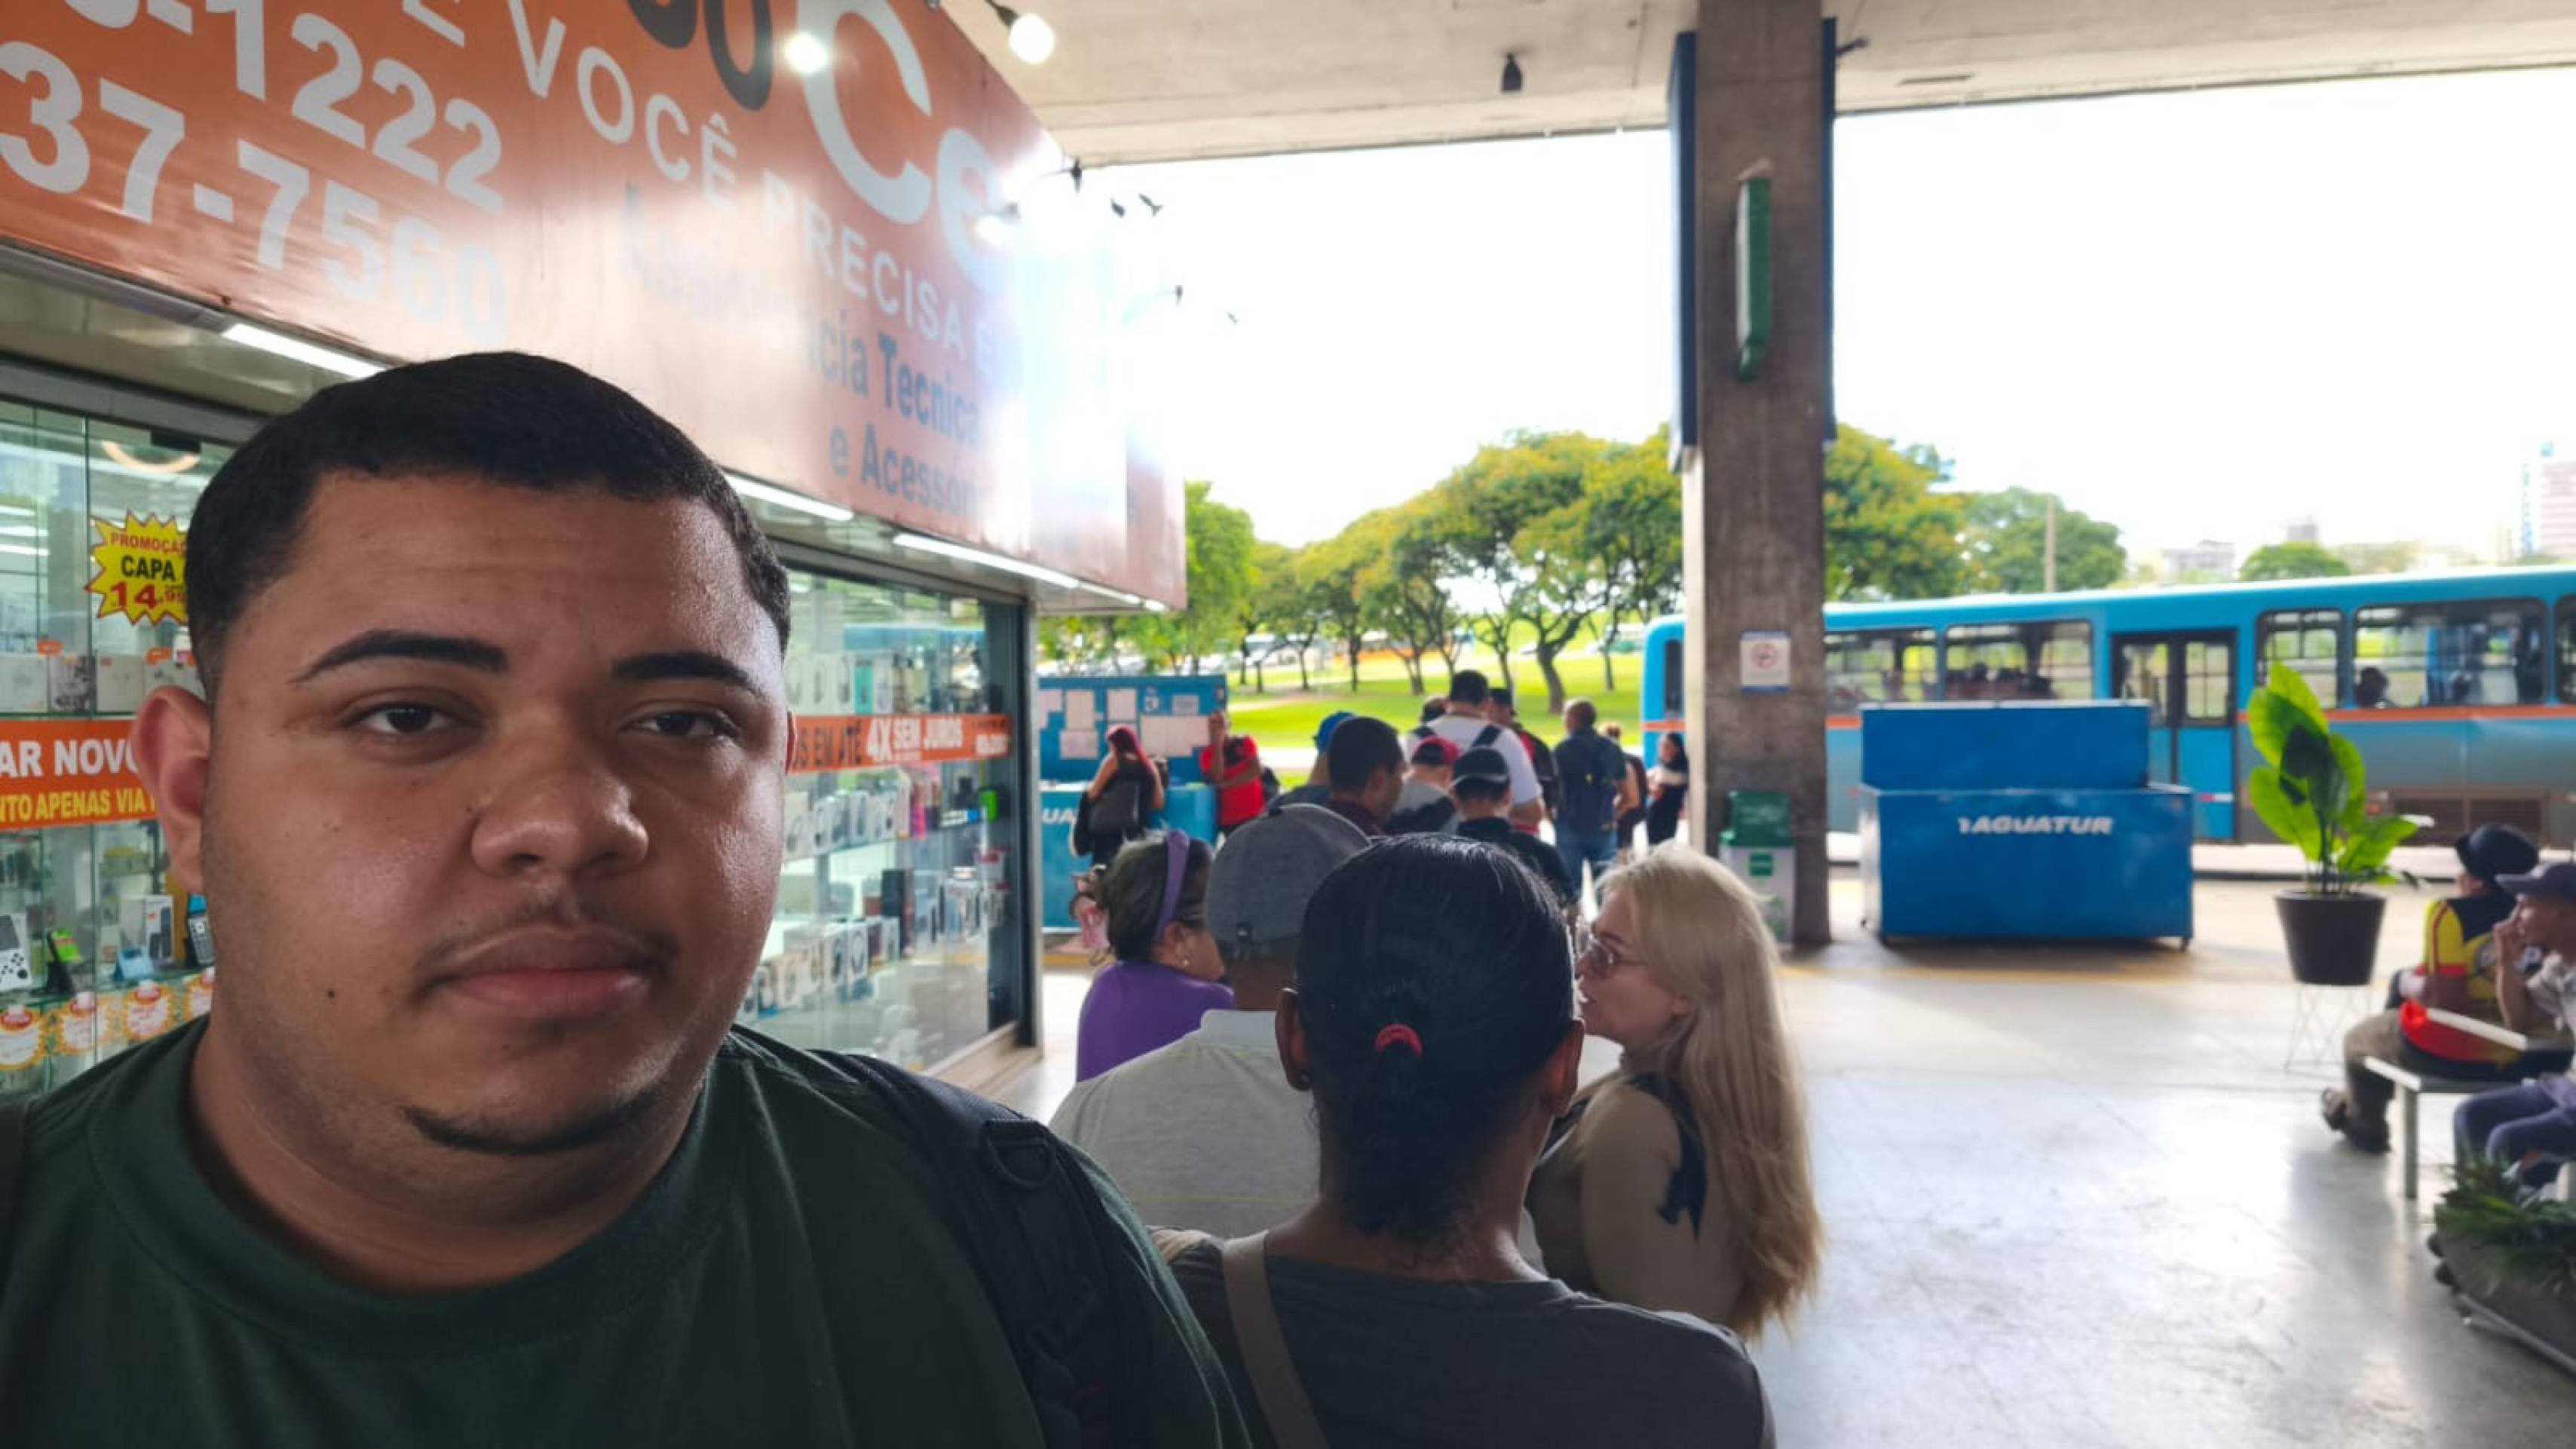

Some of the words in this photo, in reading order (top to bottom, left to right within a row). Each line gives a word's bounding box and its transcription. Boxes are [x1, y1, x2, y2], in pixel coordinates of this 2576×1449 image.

[63, 0, 504, 216] -1222
[0, 41, 507, 348] 37-7560
[507, 0, 738, 214] VOCÊ
[762, 167, 967, 363] PRECISA
[830, 425, 849, 478] e
[121, 555, 176, 581] CAPA
[866, 717, 892, 761] 4X
[36, 789, 111, 820] APENAS
[115, 787, 145, 813] VIA
